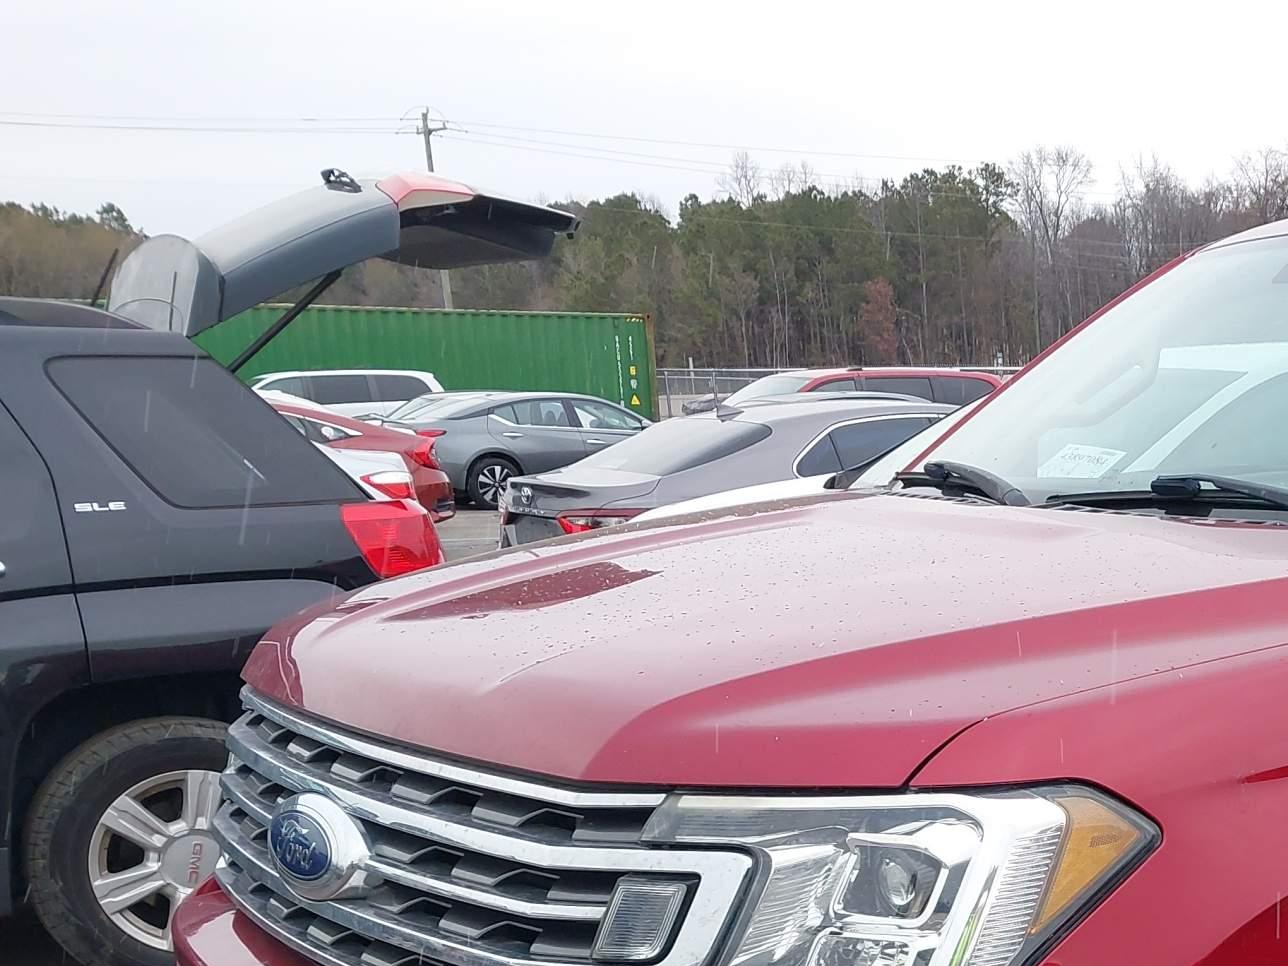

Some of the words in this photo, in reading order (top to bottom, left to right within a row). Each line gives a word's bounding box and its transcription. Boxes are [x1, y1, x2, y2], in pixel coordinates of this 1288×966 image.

[74, 501, 127, 512] SLE
[188, 841, 202, 885] GMC
[278, 819, 317, 870] Ford
